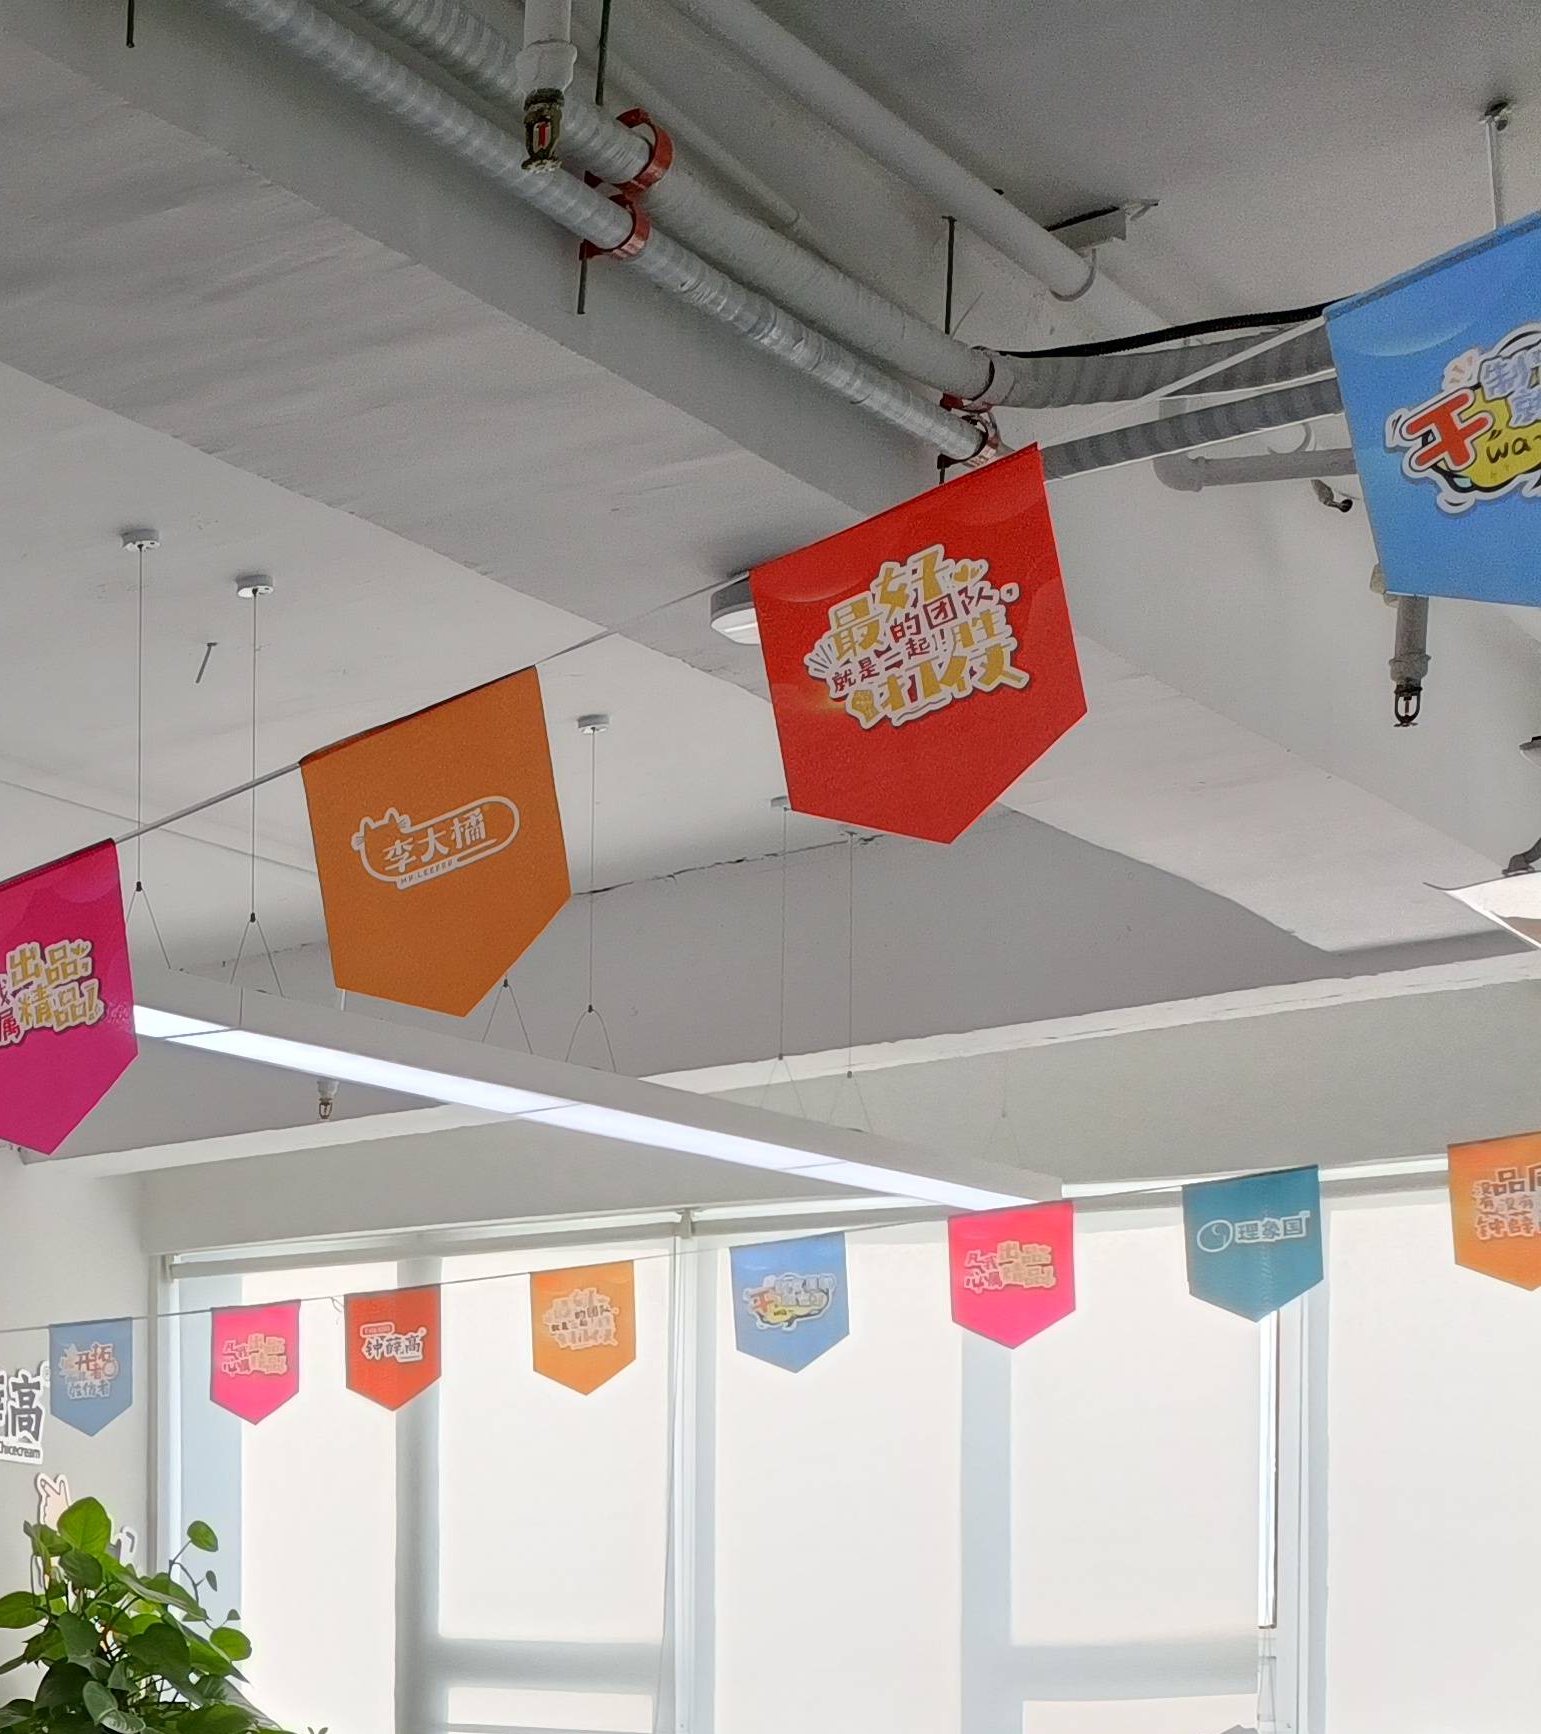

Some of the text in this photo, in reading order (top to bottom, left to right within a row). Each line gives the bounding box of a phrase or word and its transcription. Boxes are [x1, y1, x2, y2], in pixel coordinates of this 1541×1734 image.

[382, 807, 486, 873] 李大橘
[1237, 1218, 1304, 1240] 理象国
